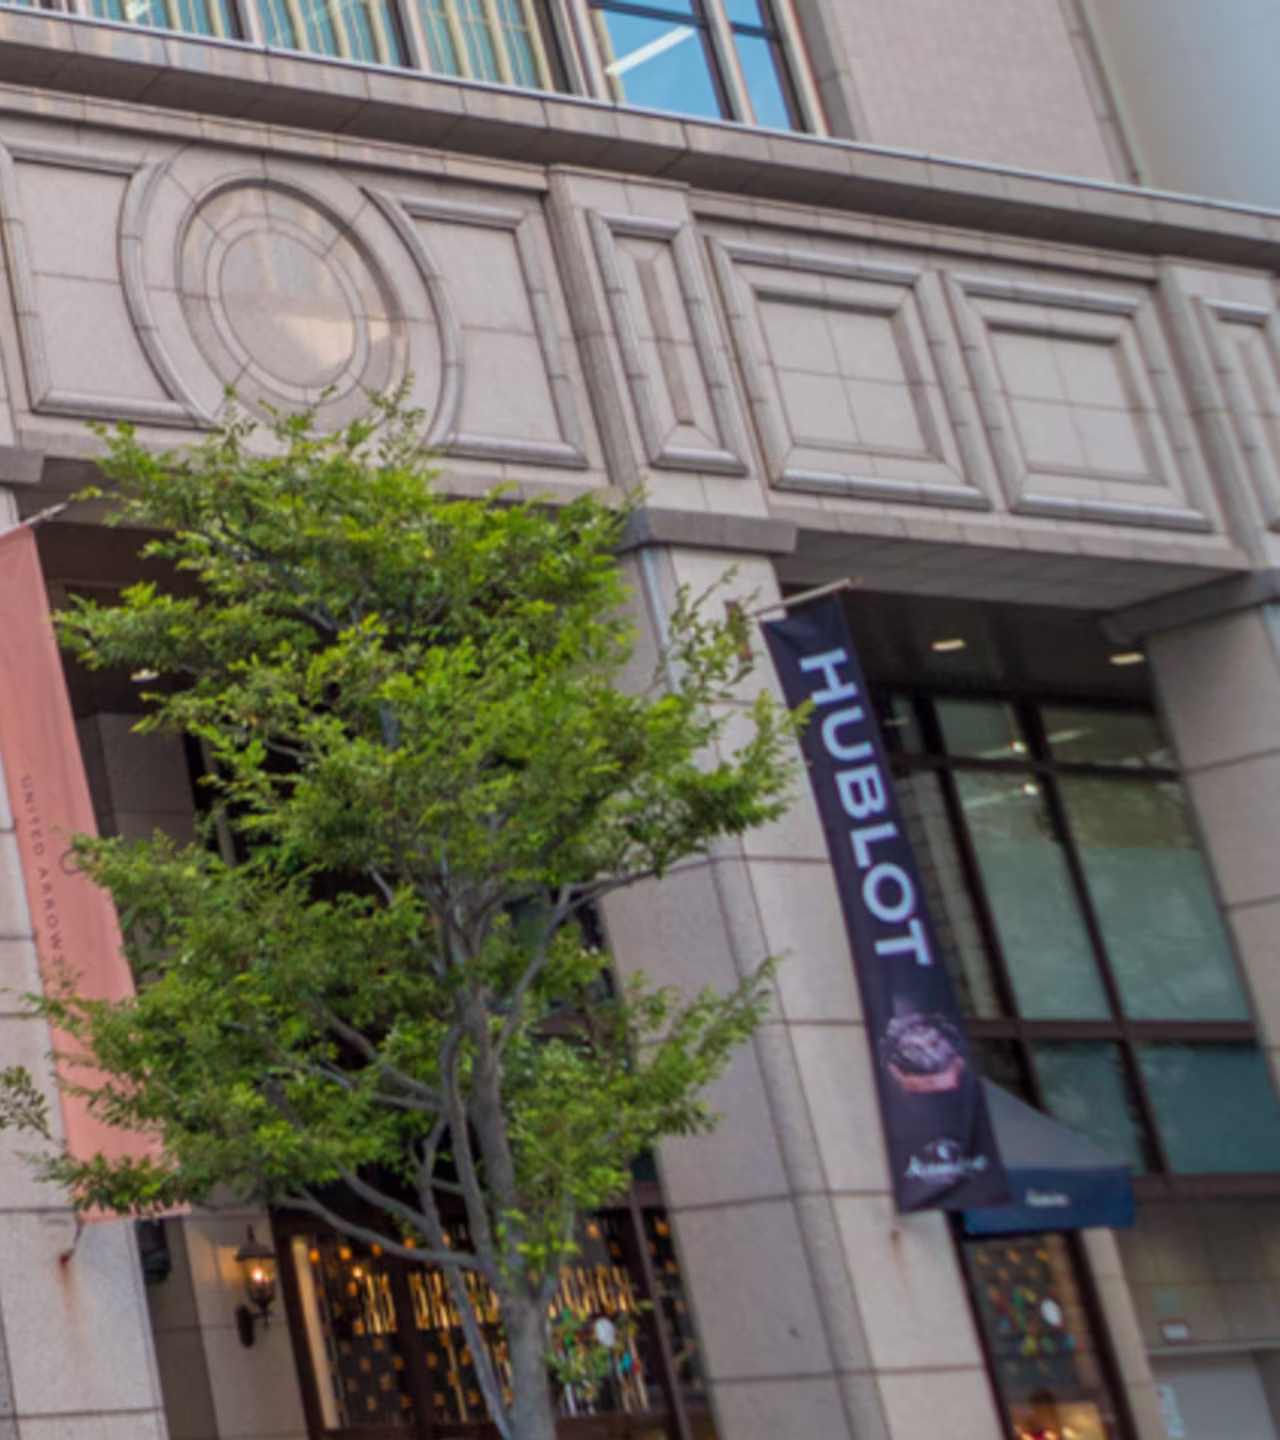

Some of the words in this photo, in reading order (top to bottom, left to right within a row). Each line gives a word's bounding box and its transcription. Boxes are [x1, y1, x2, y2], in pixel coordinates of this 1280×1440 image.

[21, 774, 45, 857] UNITED
[38, 866, 67, 967] ARROWS
[800, 647, 934, 968] HUBLOT
